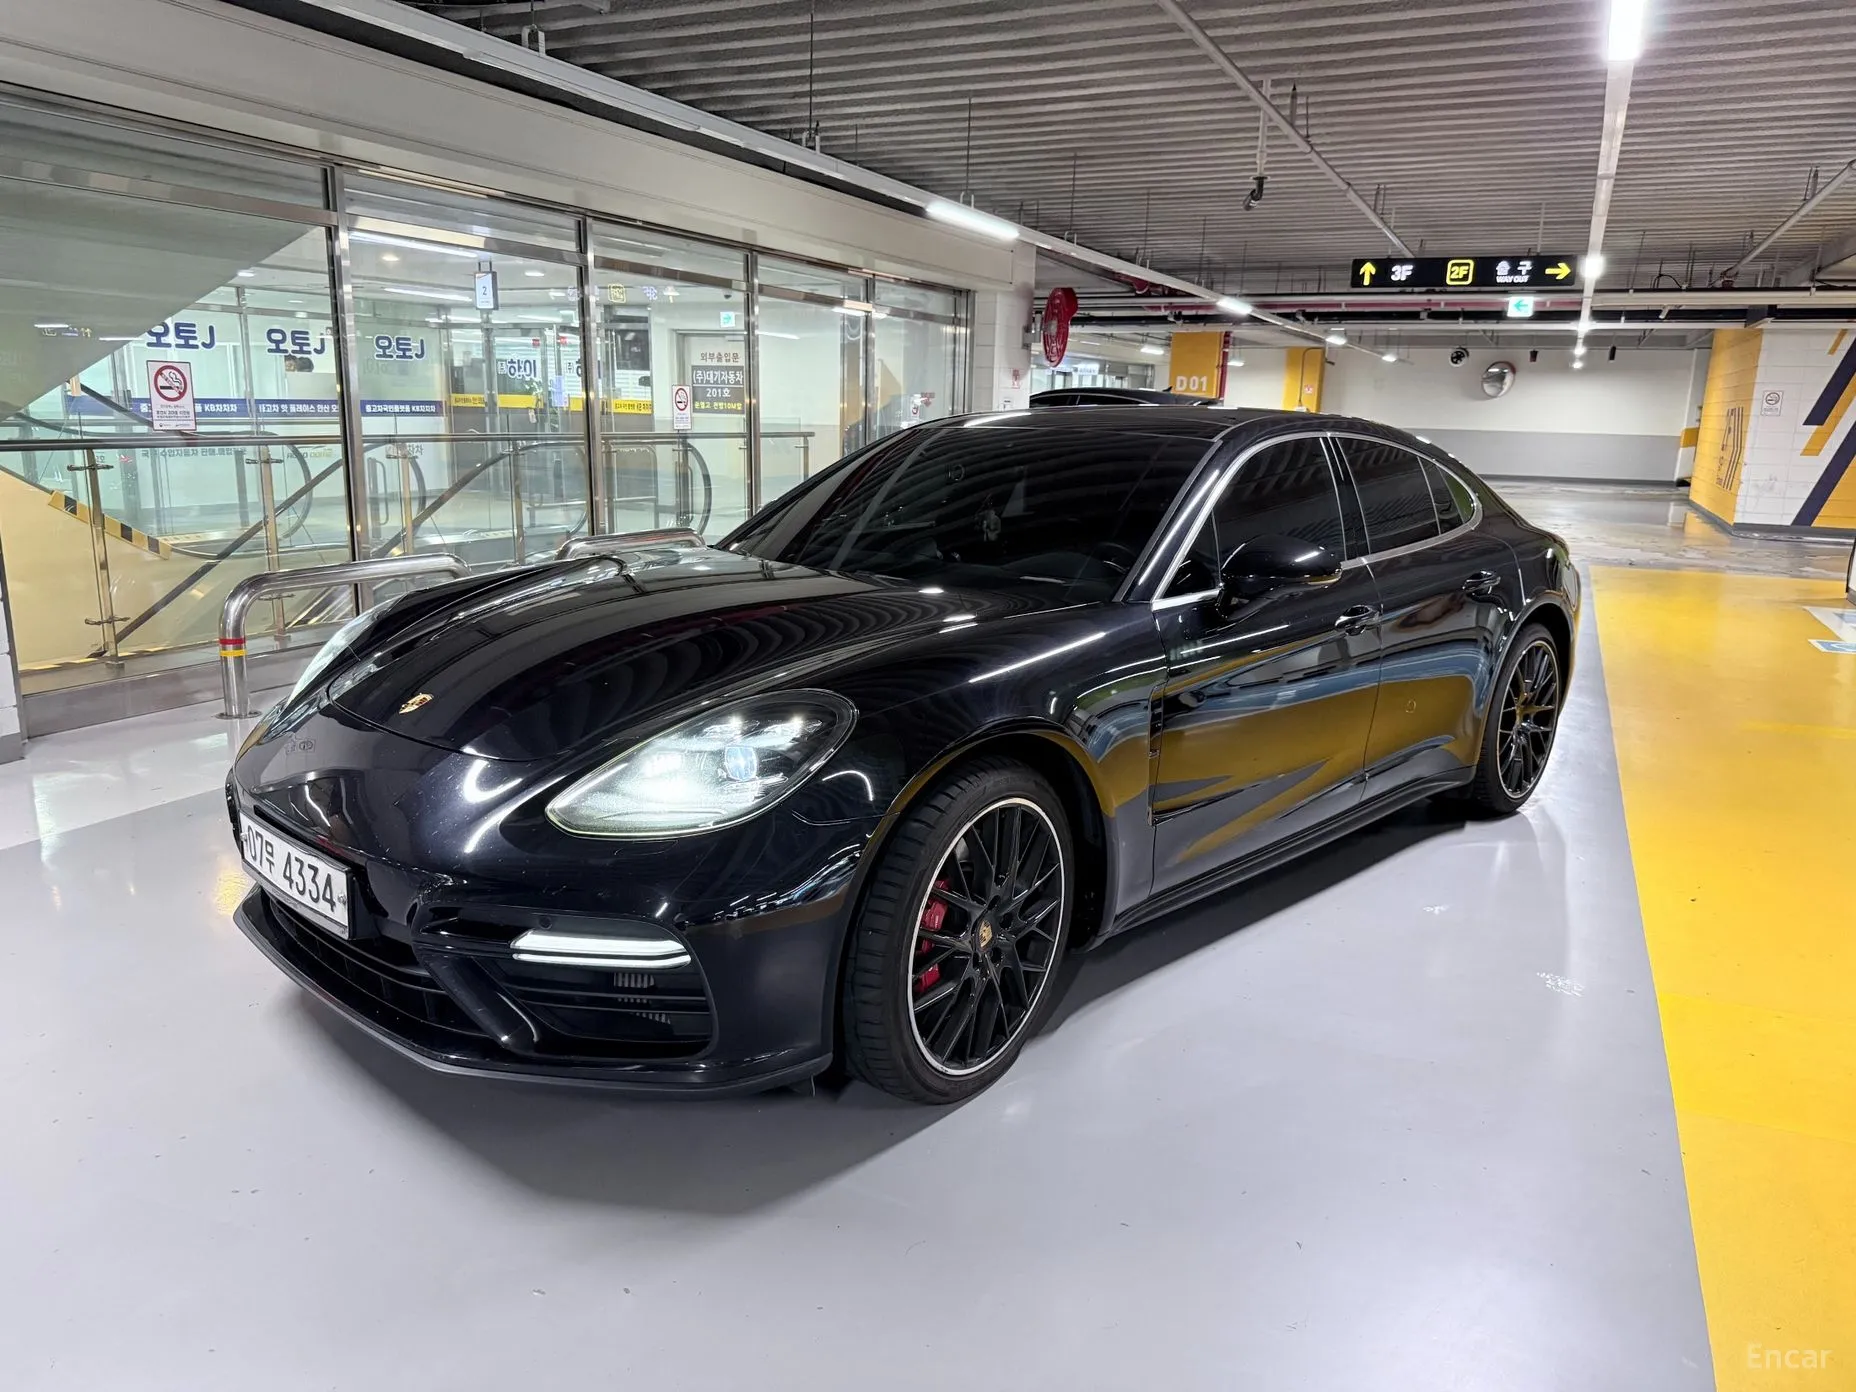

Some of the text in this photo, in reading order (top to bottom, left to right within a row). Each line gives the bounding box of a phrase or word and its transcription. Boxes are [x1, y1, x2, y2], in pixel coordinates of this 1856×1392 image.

[1390, 265, 1414, 281] 3F
[1450, 266, 1468, 279] 2F
[1496, 275, 1530, 283] WAY OUT
[482, 286, 487, 296] 2
[146, 321, 215, 349] 오토J
[266, 328, 326, 355] 오토J
[375, 335, 425, 359] 오토J
[701, 352, 740, 362] 외부출입문
[693, 370, 743, 384] (주)대기자동차
[706, 388, 731, 397] 201호
[283, 851, 336, 913] 4334
